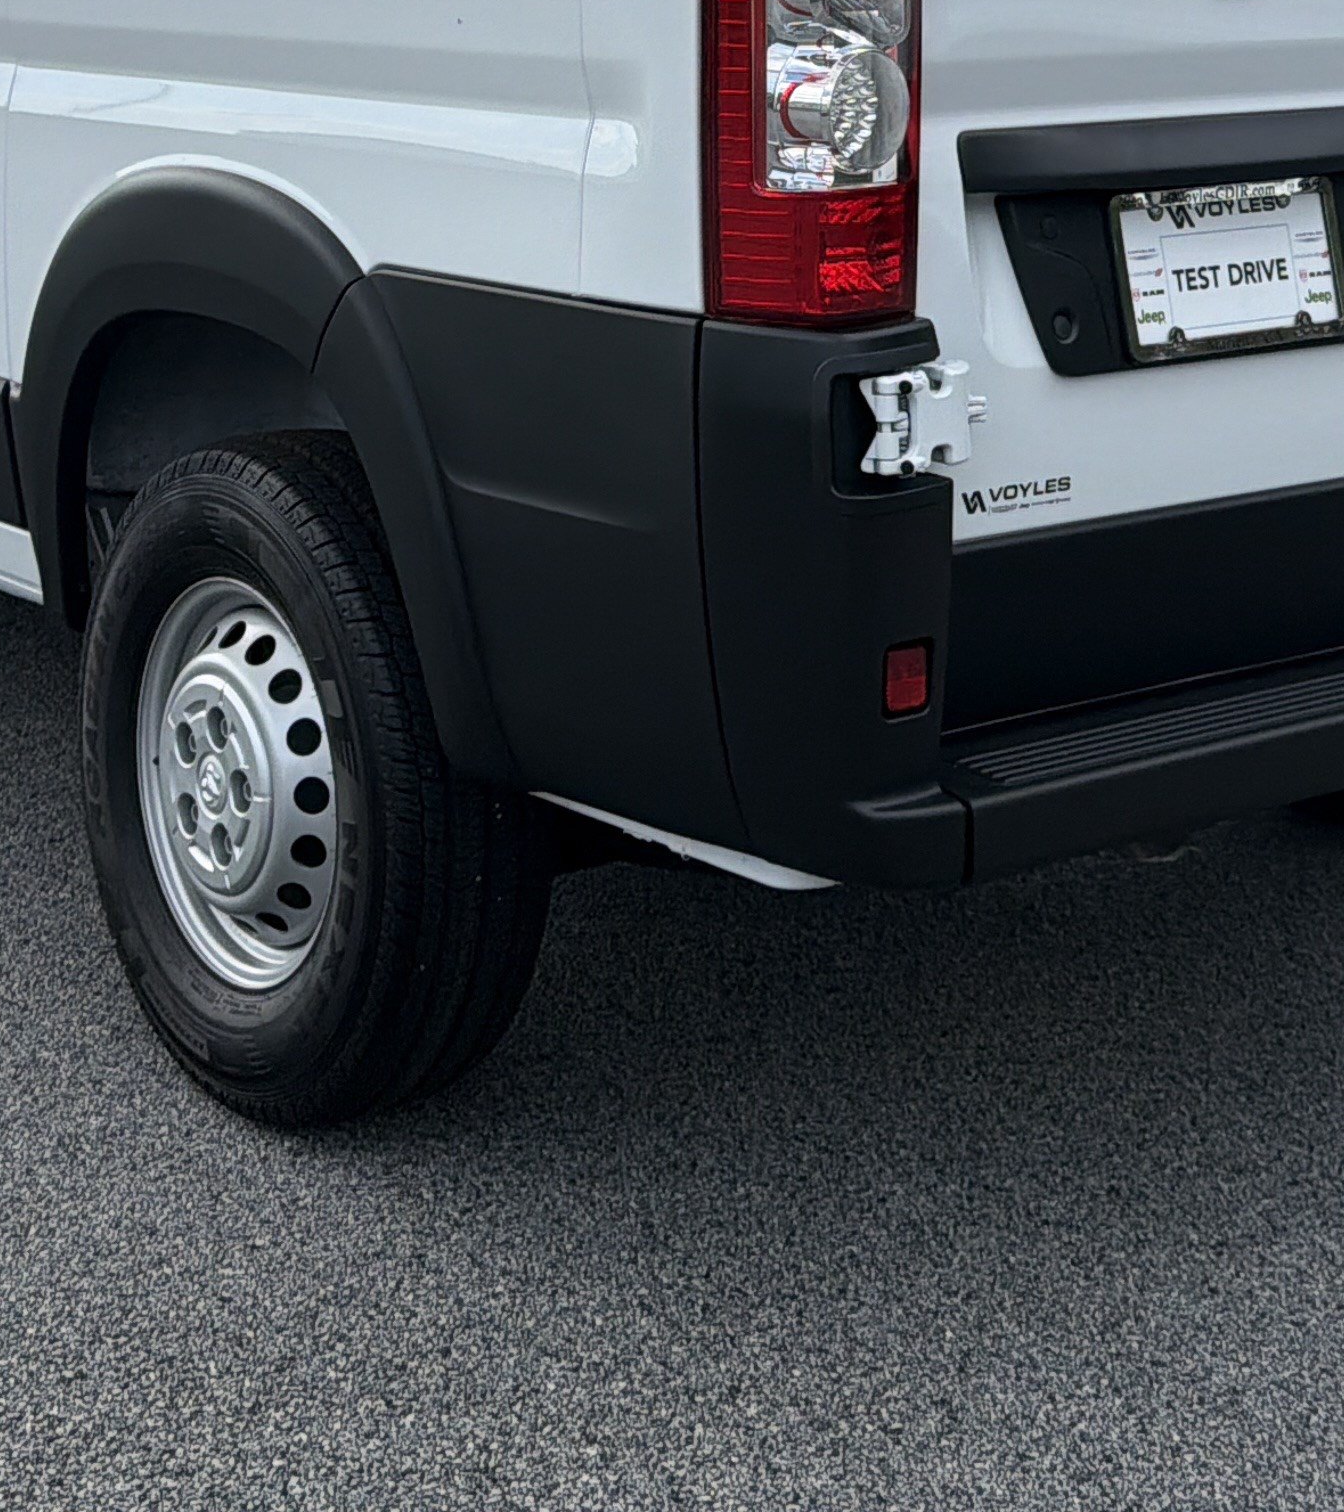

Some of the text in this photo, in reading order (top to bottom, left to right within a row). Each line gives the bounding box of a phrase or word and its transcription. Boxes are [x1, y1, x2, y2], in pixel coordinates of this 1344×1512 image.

[1195, 194, 1276, 219] VOYLES
[1172, 257, 1289, 292] TEST DRIVE
[1304, 288, 1333, 305] Jeep
[1137, 309, 1167, 326] Jeep
[989, 476, 1071, 502] VOYLES
